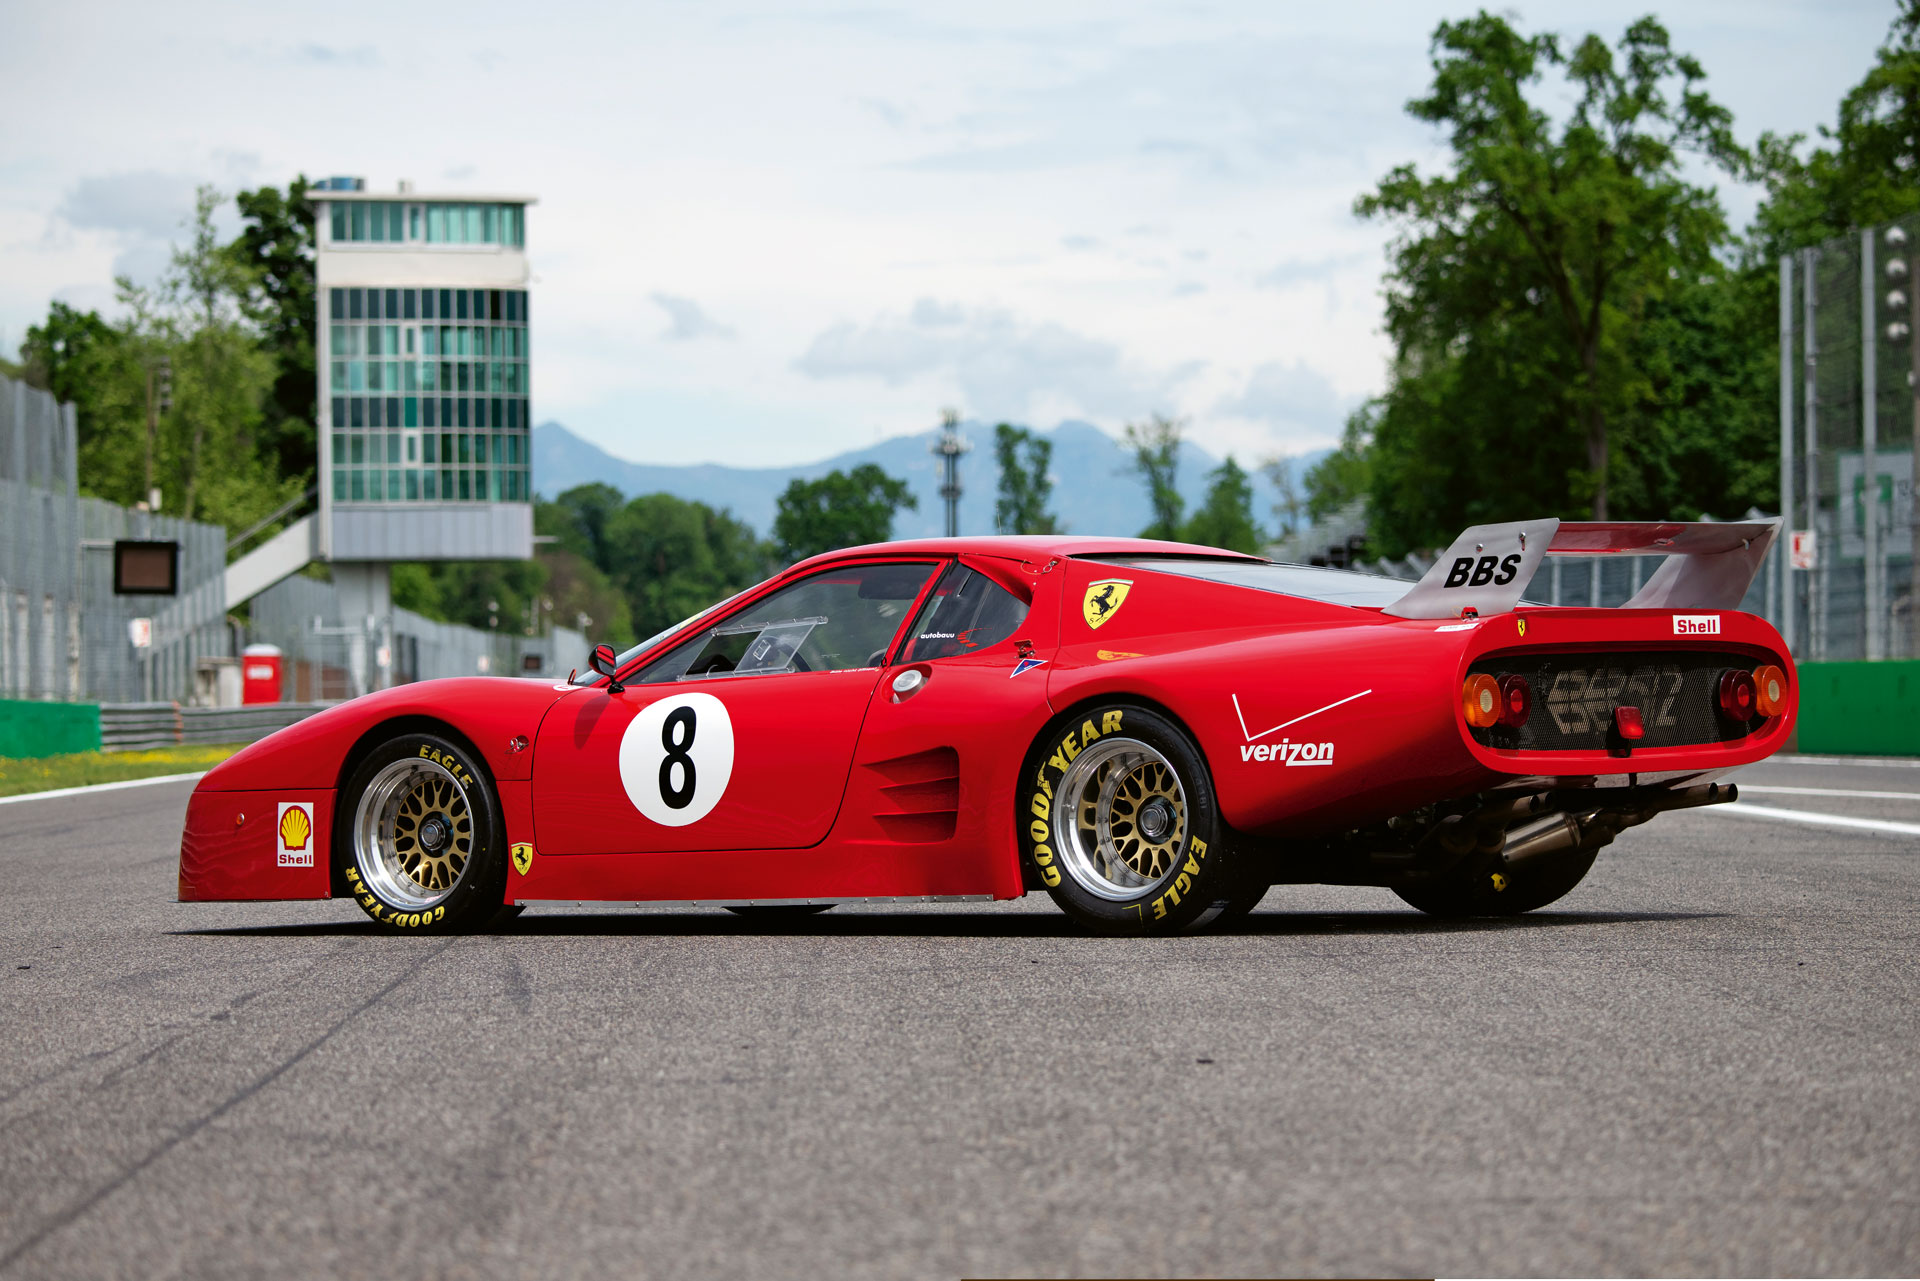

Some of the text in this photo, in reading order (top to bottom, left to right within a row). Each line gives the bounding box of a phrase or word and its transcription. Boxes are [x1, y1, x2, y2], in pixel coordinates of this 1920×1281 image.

[1444, 554, 1522, 588] BBS
[1677, 619, 1716, 633] Shell
[419, 744, 475, 790] EAGLE
[658, 706, 697, 810] 8
[1240, 738, 1335, 767] verizon
[279, 854, 312, 864] Shell
[1151, 834, 1208, 920] EAGLE
